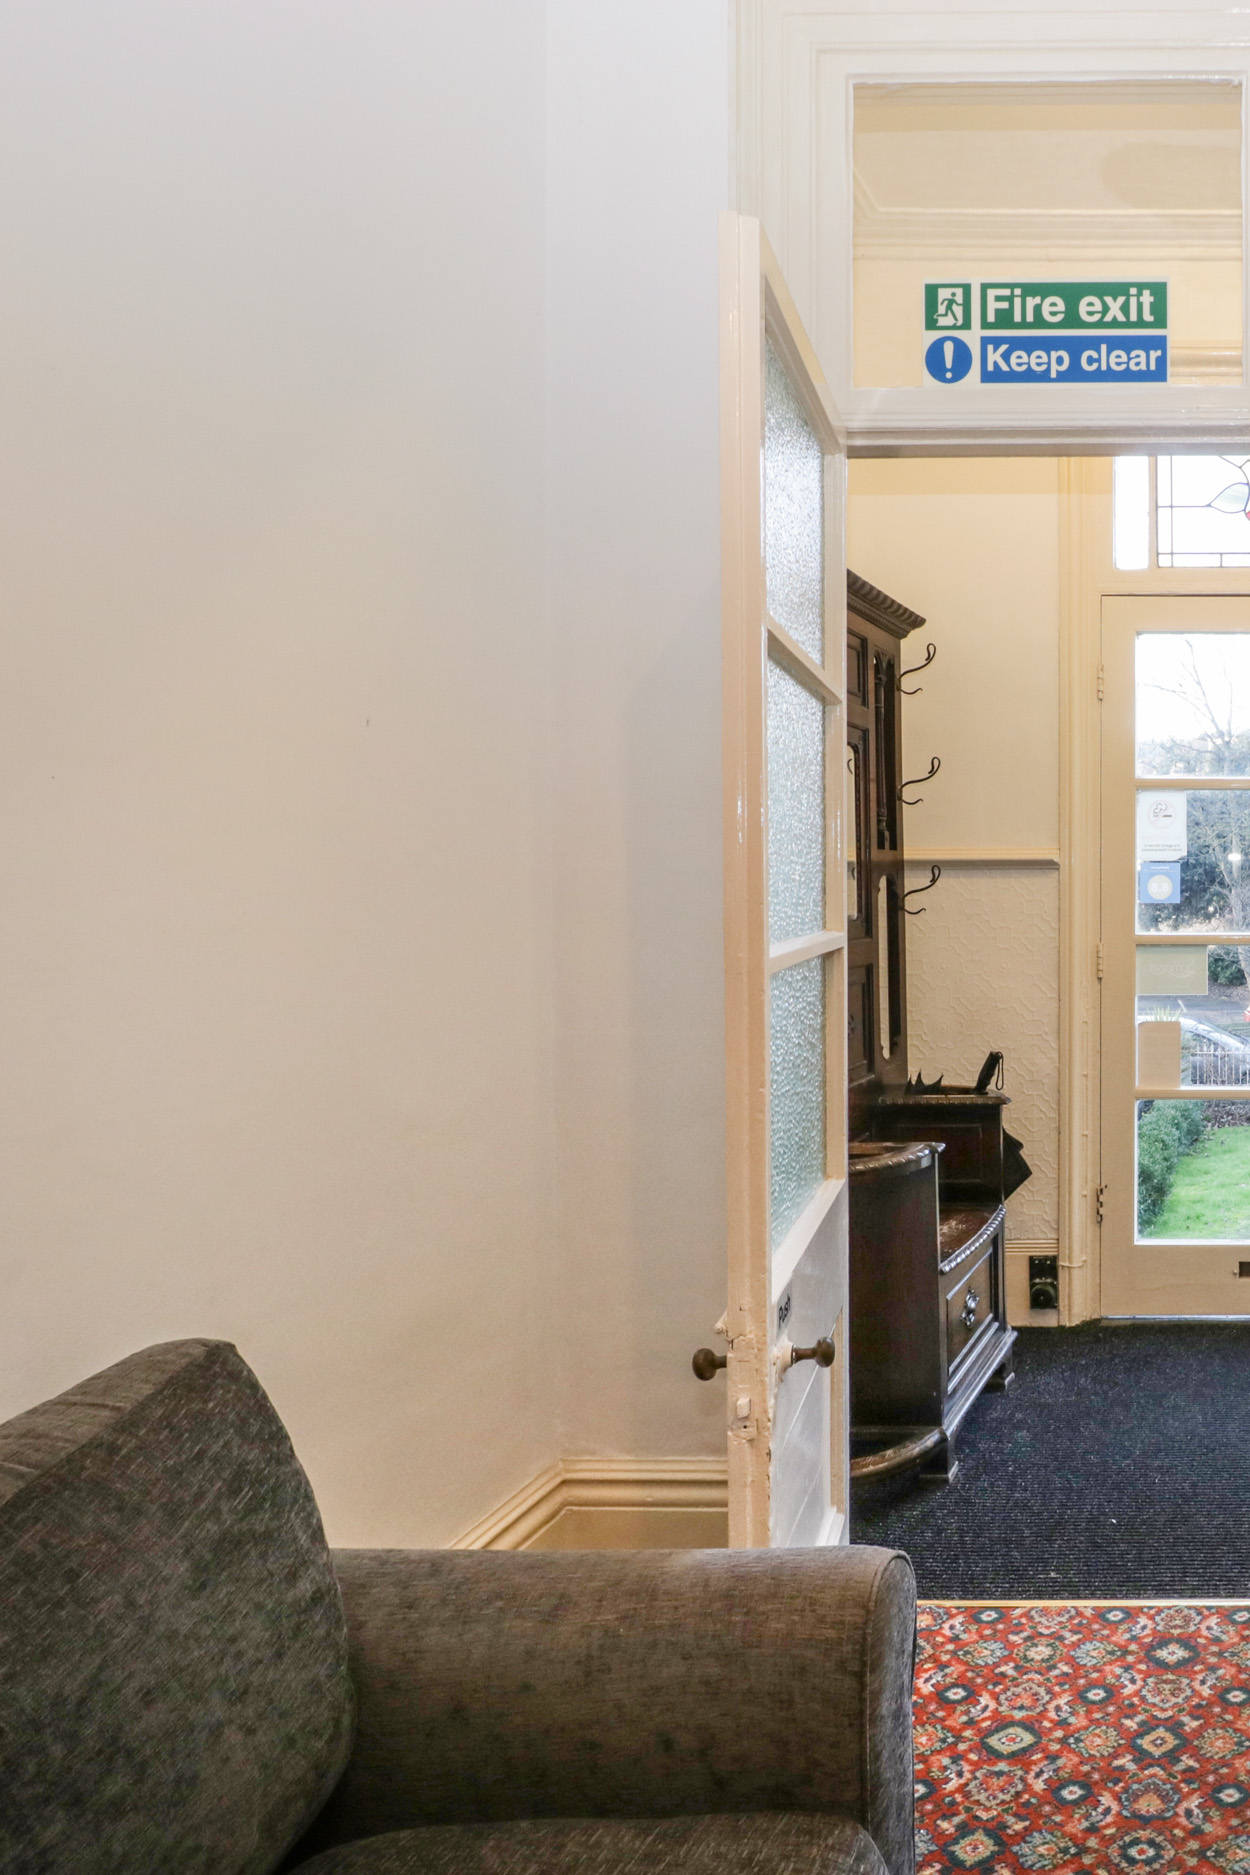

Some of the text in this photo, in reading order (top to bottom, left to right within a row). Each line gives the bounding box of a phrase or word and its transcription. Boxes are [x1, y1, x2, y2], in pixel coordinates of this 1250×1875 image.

[986, 287, 1154, 323] Fire exit
[986, 343, 1162, 378] Keep clear
[778, 1294, 791, 1330] Push
